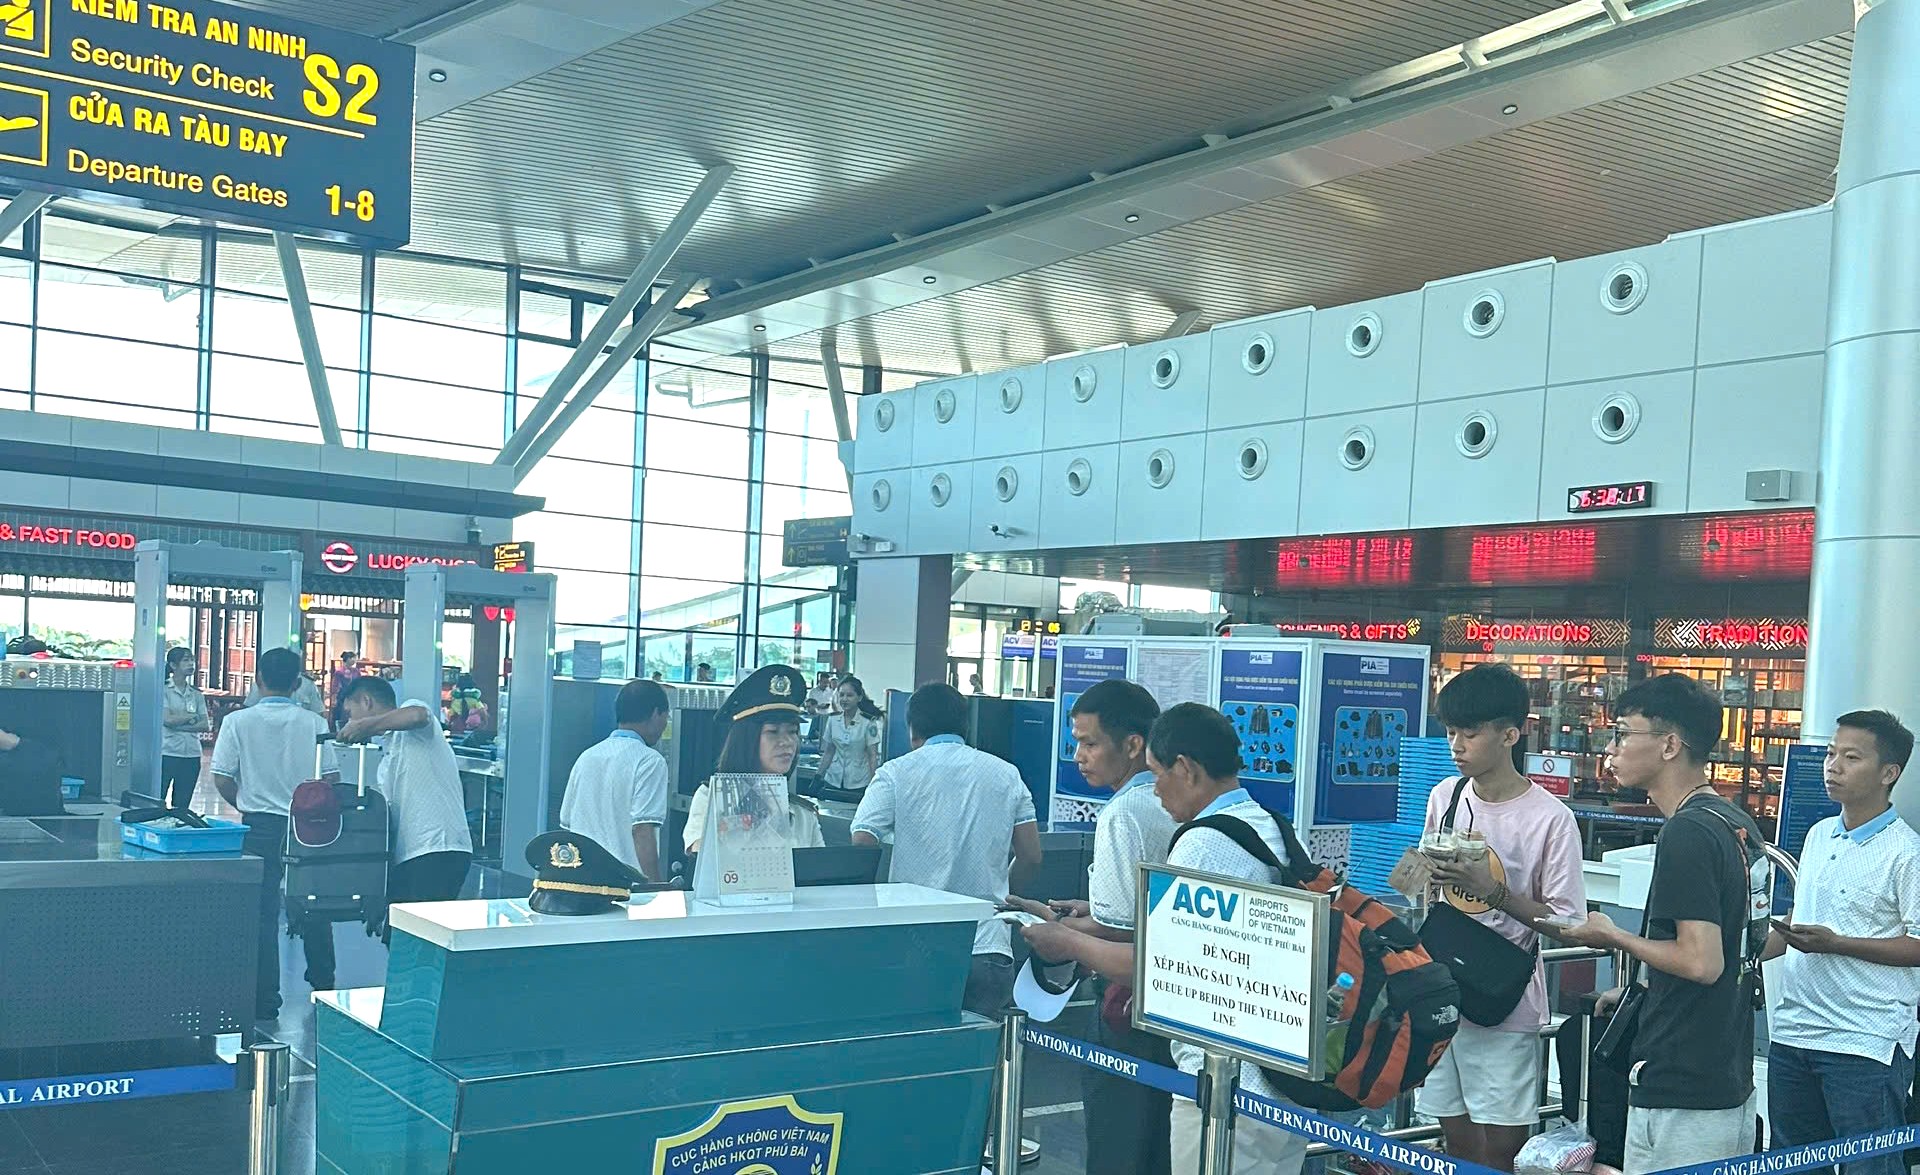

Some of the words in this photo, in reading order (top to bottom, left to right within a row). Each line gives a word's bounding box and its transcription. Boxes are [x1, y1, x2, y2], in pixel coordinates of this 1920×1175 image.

[148, 3, 197, 37] TRA
[205, 17, 238, 46] AN
[248, 26, 306, 60] NINH
[71, 38, 184, 86] Security
[191, 63, 275, 100] Check
[303, 53, 379, 126] S2
[69, 91, 124, 128] CỬA
[134, 107, 171, 137] RA
[180, 113, 230, 147] TÀU
[239, 127, 288, 158] BAY
[68, 148, 204, 194] Departure
[211, 174, 288, 208] Gates
[325, 184, 375, 222] 1-8
[0, 523, 16, 541] &
[20, 526, 73, 545] FAST
[76, 530, 135, 549] FOOD
[1004, 637, 1019, 645] ACV
[1350, 624, 1361, 639] &
[1364, 623, 1407, 639] GIFTS
[1466, 624, 1591, 641] DECORATIONS
[1361, 661, 1377, 670] PIA
[723, 873, 739, 884] 09
[1173, 883, 1239, 922] ACV
[1249, 897, 1289, 912] AIRPORTS
[1248, 919, 1260, 929] OF
[1261, 921, 1296, 936] VIETNAM
[1249, 908, 1306, 927] CORPORATION
[1221, 948, 1251, 970] NGHỊ
[1153, 954, 1175, 971] XẾP
[1177, 961, 1209, 981] HÀNG
[1211, 970, 1234, 987] SAU
[1236, 976, 1270, 996] VẠCH
[1273, 984, 1308, 1007] VÀNG
[1152, 978, 1183, 996] QUEUE
[1185, 987, 1198, 999] UP
[1200, 991, 1236, 1010] BEHIND
[1238, 1001, 1258, 1016] THE
[1260, 1006, 1305, 1028] YELLOW
[1213, 1011, 1237, 1027] LINE
[1087, 1050, 1139, 1077] AIRPORT
[30, 1078, 134, 1101] AIRPORT
[672, 1148, 698, 1168] CỤC
[701, 1136, 734, 1156] HÀNG
[737, 1128, 778, 1146] KHÔNG
[781, 1126, 806, 1142] VIỆT
[806, 1130, 830, 1145] NAM
[1248, 1098, 1374, 1153] INTERNATIONAL
[1378, 1141, 1457, 1175] AIRPORT
[693, 1157, 727, 1174] CẢNG
[730, 1147, 763, 1164] HKQT
[765, 1142, 788, 1157] PHÚ
[790, 1144, 809, 1157] BÀI
[1750, 1155, 1784, 1175] HÀNG
[1785, 1146, 1826, 1169] KHÔNG
[1828, 1138, 1859, 1163] QUỐC
[1860, 1137, 1873, 1154] TẾ
[1874, 1129, 1896, 1150] PHÚ
